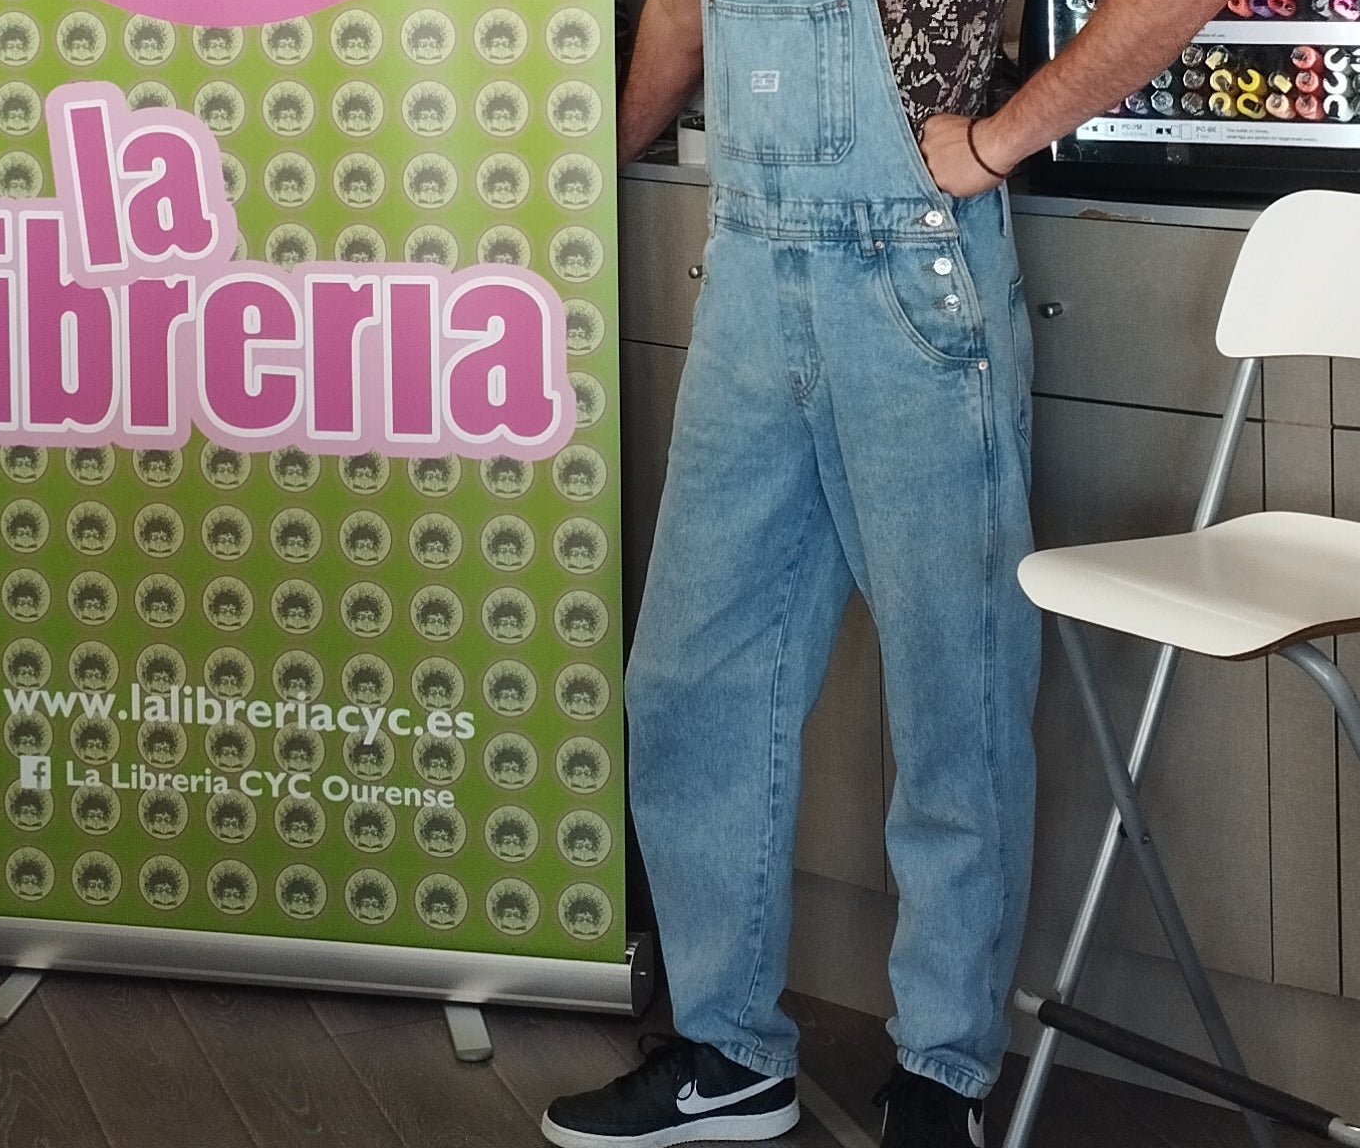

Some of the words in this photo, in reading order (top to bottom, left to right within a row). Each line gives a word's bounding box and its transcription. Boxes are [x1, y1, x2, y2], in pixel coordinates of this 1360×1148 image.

[61, 96, 219, 274] la
[4, 684, 476, 745] www.lalibreriacyc.es
[65, 760, 101, 788] La
[112, 764, 229, 795] Libreria
[239, 770, 312, 799] CYC
[322, 775, 455, 809] Ourense
